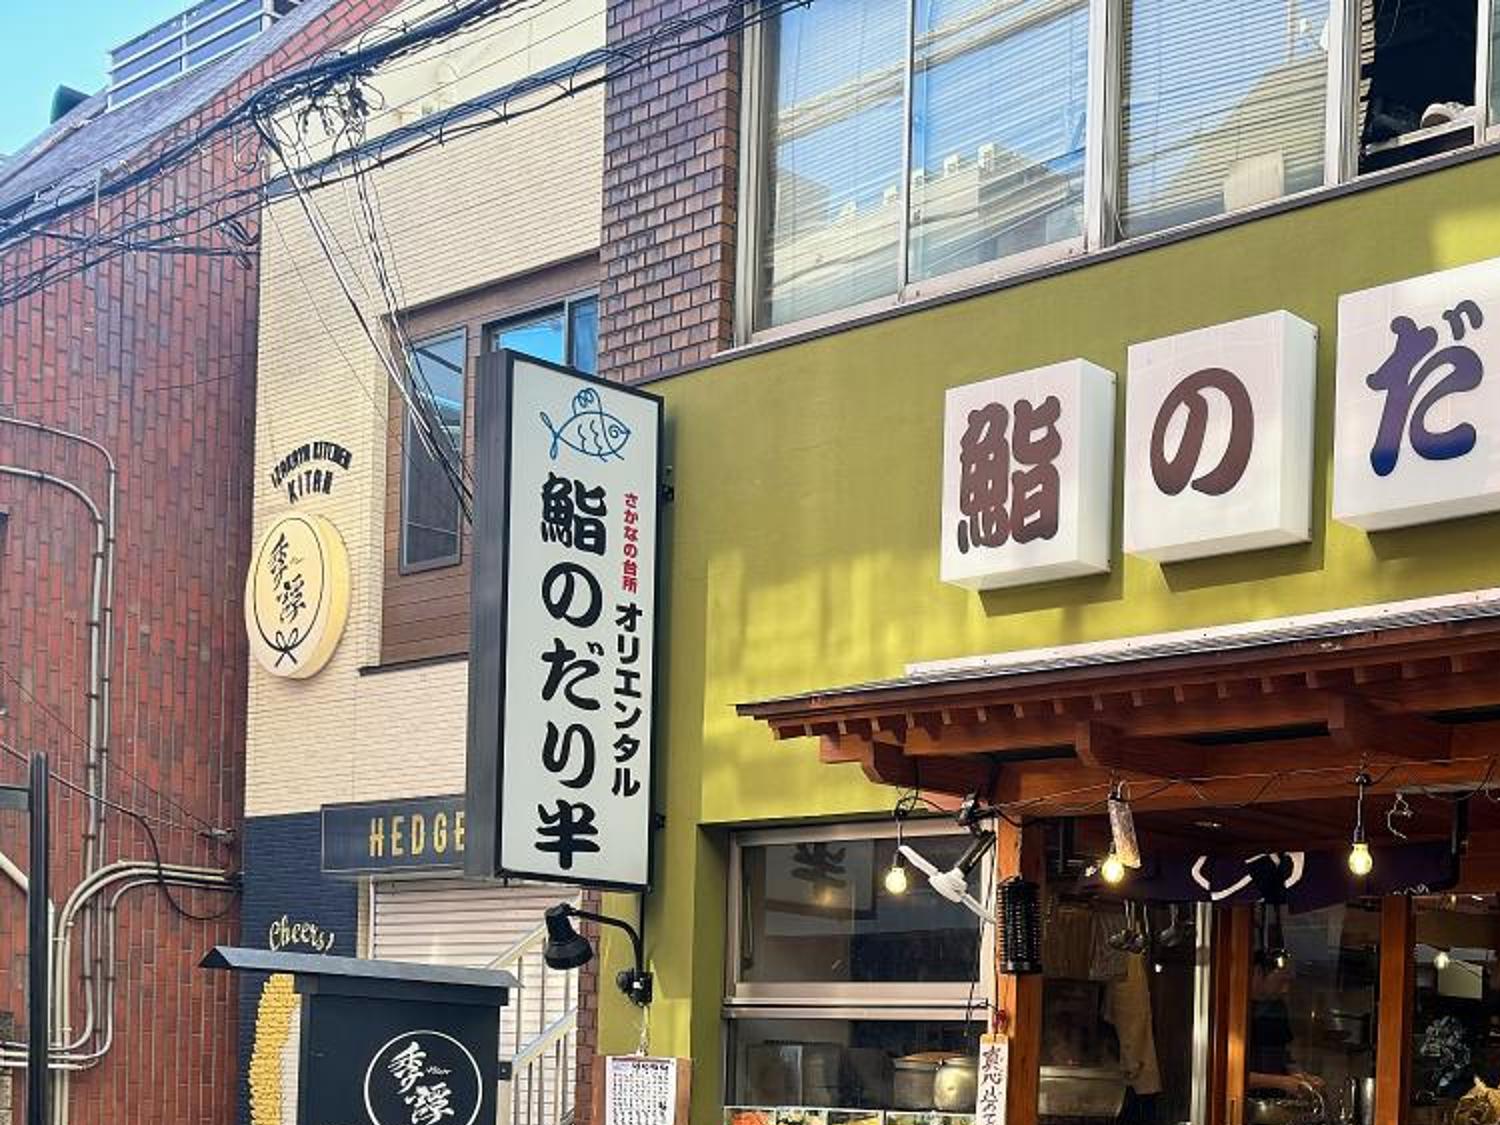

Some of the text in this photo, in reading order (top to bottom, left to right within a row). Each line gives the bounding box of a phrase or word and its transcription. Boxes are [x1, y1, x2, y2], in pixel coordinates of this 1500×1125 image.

[287, 468, 334, 504] KITAN
[533, 471, 609, 871] 鮨のだり半
[610, 491, 644, 798] さかなの台所 オリエンタル
[368, 810, 465, 858] HEDGE
